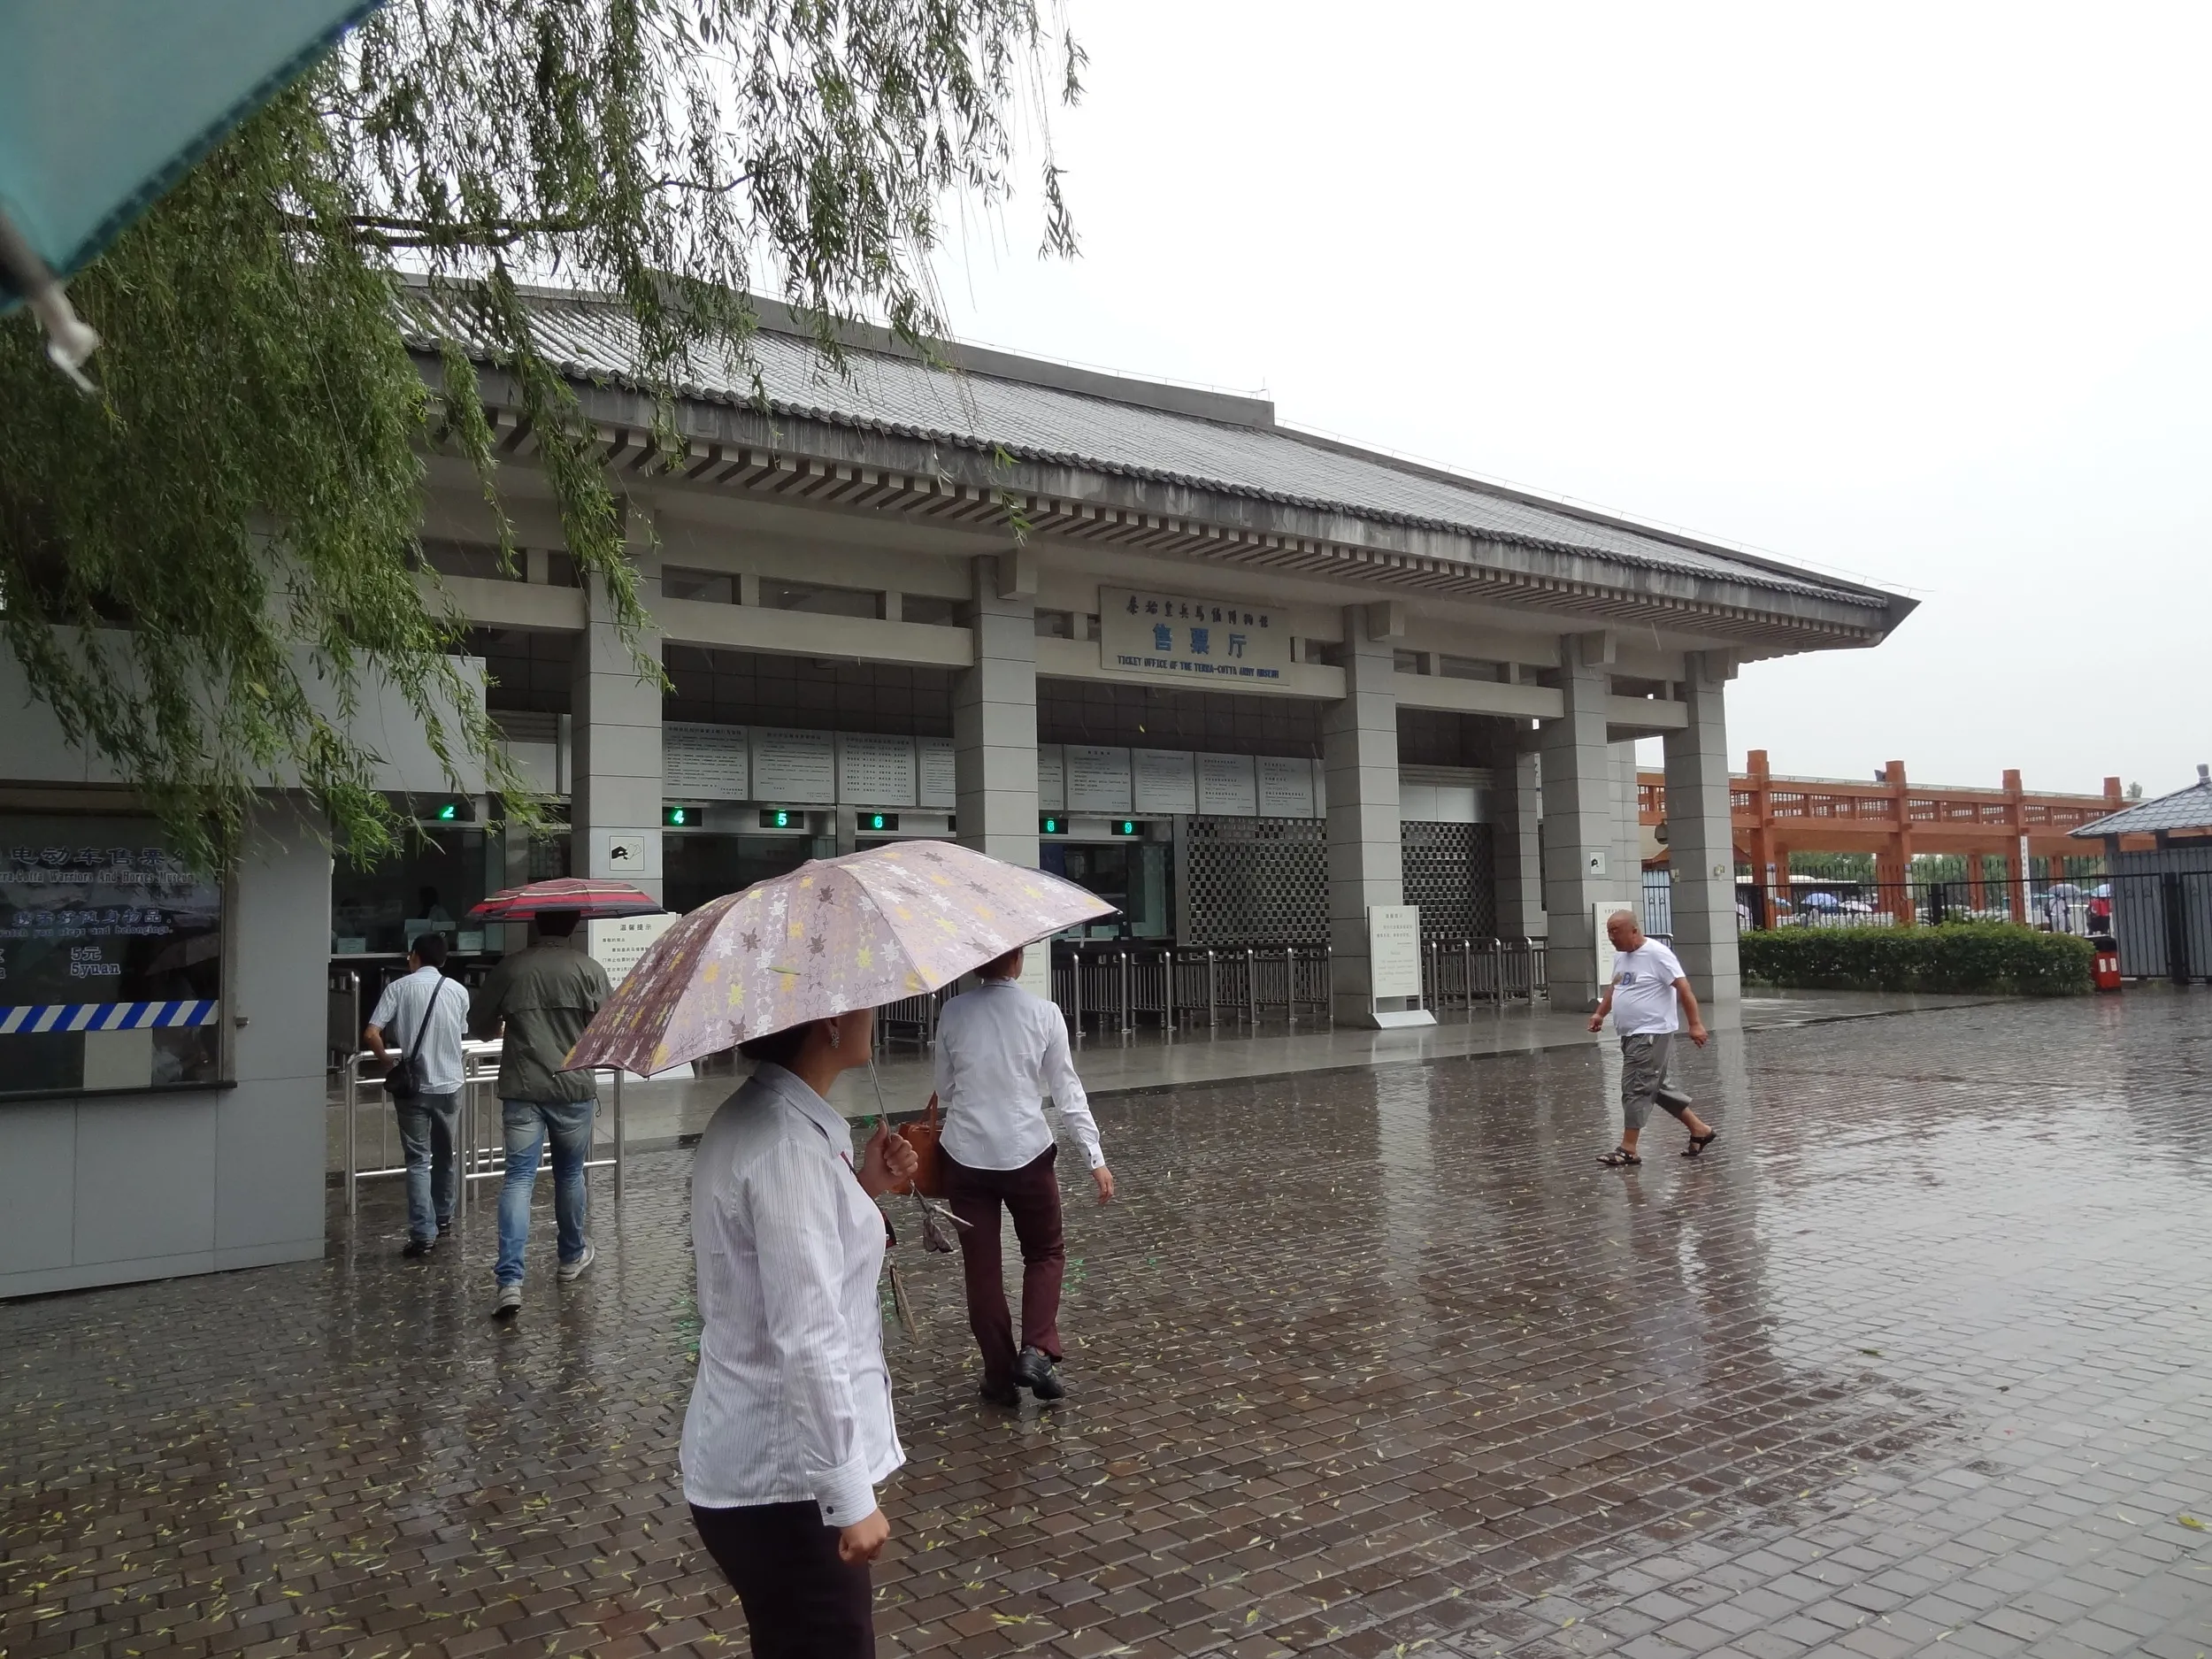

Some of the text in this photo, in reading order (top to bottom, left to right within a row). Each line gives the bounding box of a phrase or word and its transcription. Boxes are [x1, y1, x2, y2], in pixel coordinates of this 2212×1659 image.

[1153, 623, 1247, 658] 售票厅
[1118, 655, 1279, 680] TICKET OFFICE OF THE TERRA-COTTA ARMY MUSEUM
[442, 806, 454, 818] 2
[673, 810, 685, 824] 4
[778, 812, 787, 826] 5
[874, 815, 883, 828] 6
[49, 870, 94, 883] Warriors
[98, 870, 119, 883] And
[123, 870, 154, 883] Horses
[91, 926, 111, 936] and
[71, 947, 102, 961] 5元
[70, 961, 121, 978] 5yuan
